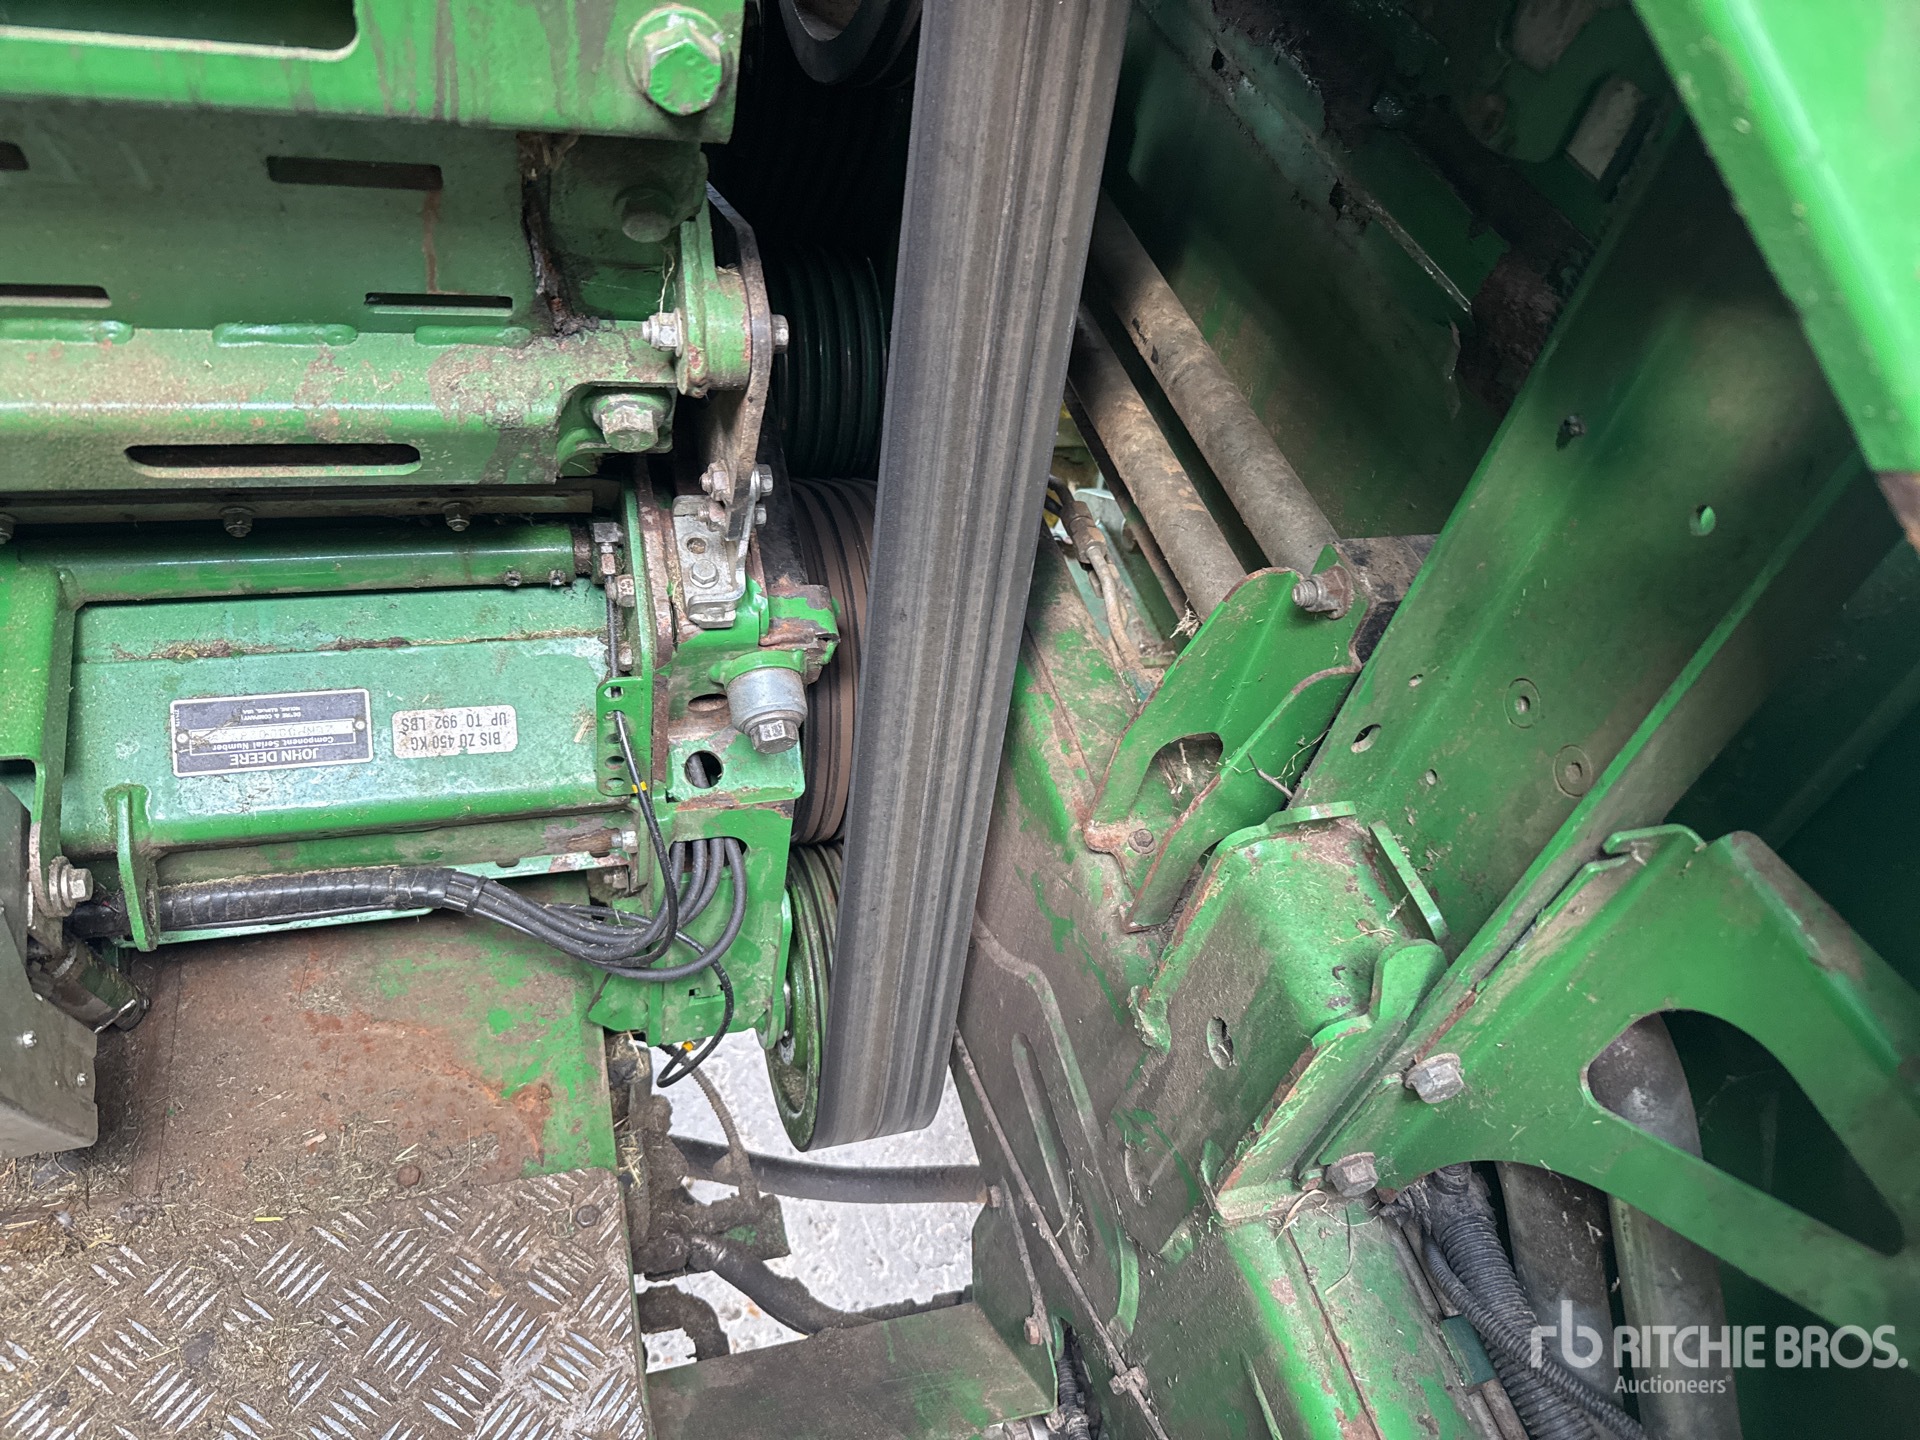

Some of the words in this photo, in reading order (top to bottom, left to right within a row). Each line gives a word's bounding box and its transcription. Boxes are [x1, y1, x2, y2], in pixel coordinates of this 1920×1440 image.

[401, 717, 426, 732] LBS
[435, 715, 457, 729] 992
[466, 714, 482, 727] TO
[491, 712, 506, 726] UP
[253, 740, 279, 749] Serial
[283, 736, 334, 746] Component
[411, 736, 427, 751] KG
[432, 735, 455, 749] 450
[459, 734, 475, 748] ZU
[480, 732, 501, 746] BIS
[212, 743, 249, 751] Number
[282, 747, 319, 761] JOHN
[230, 751, 277, 765] DEERE
